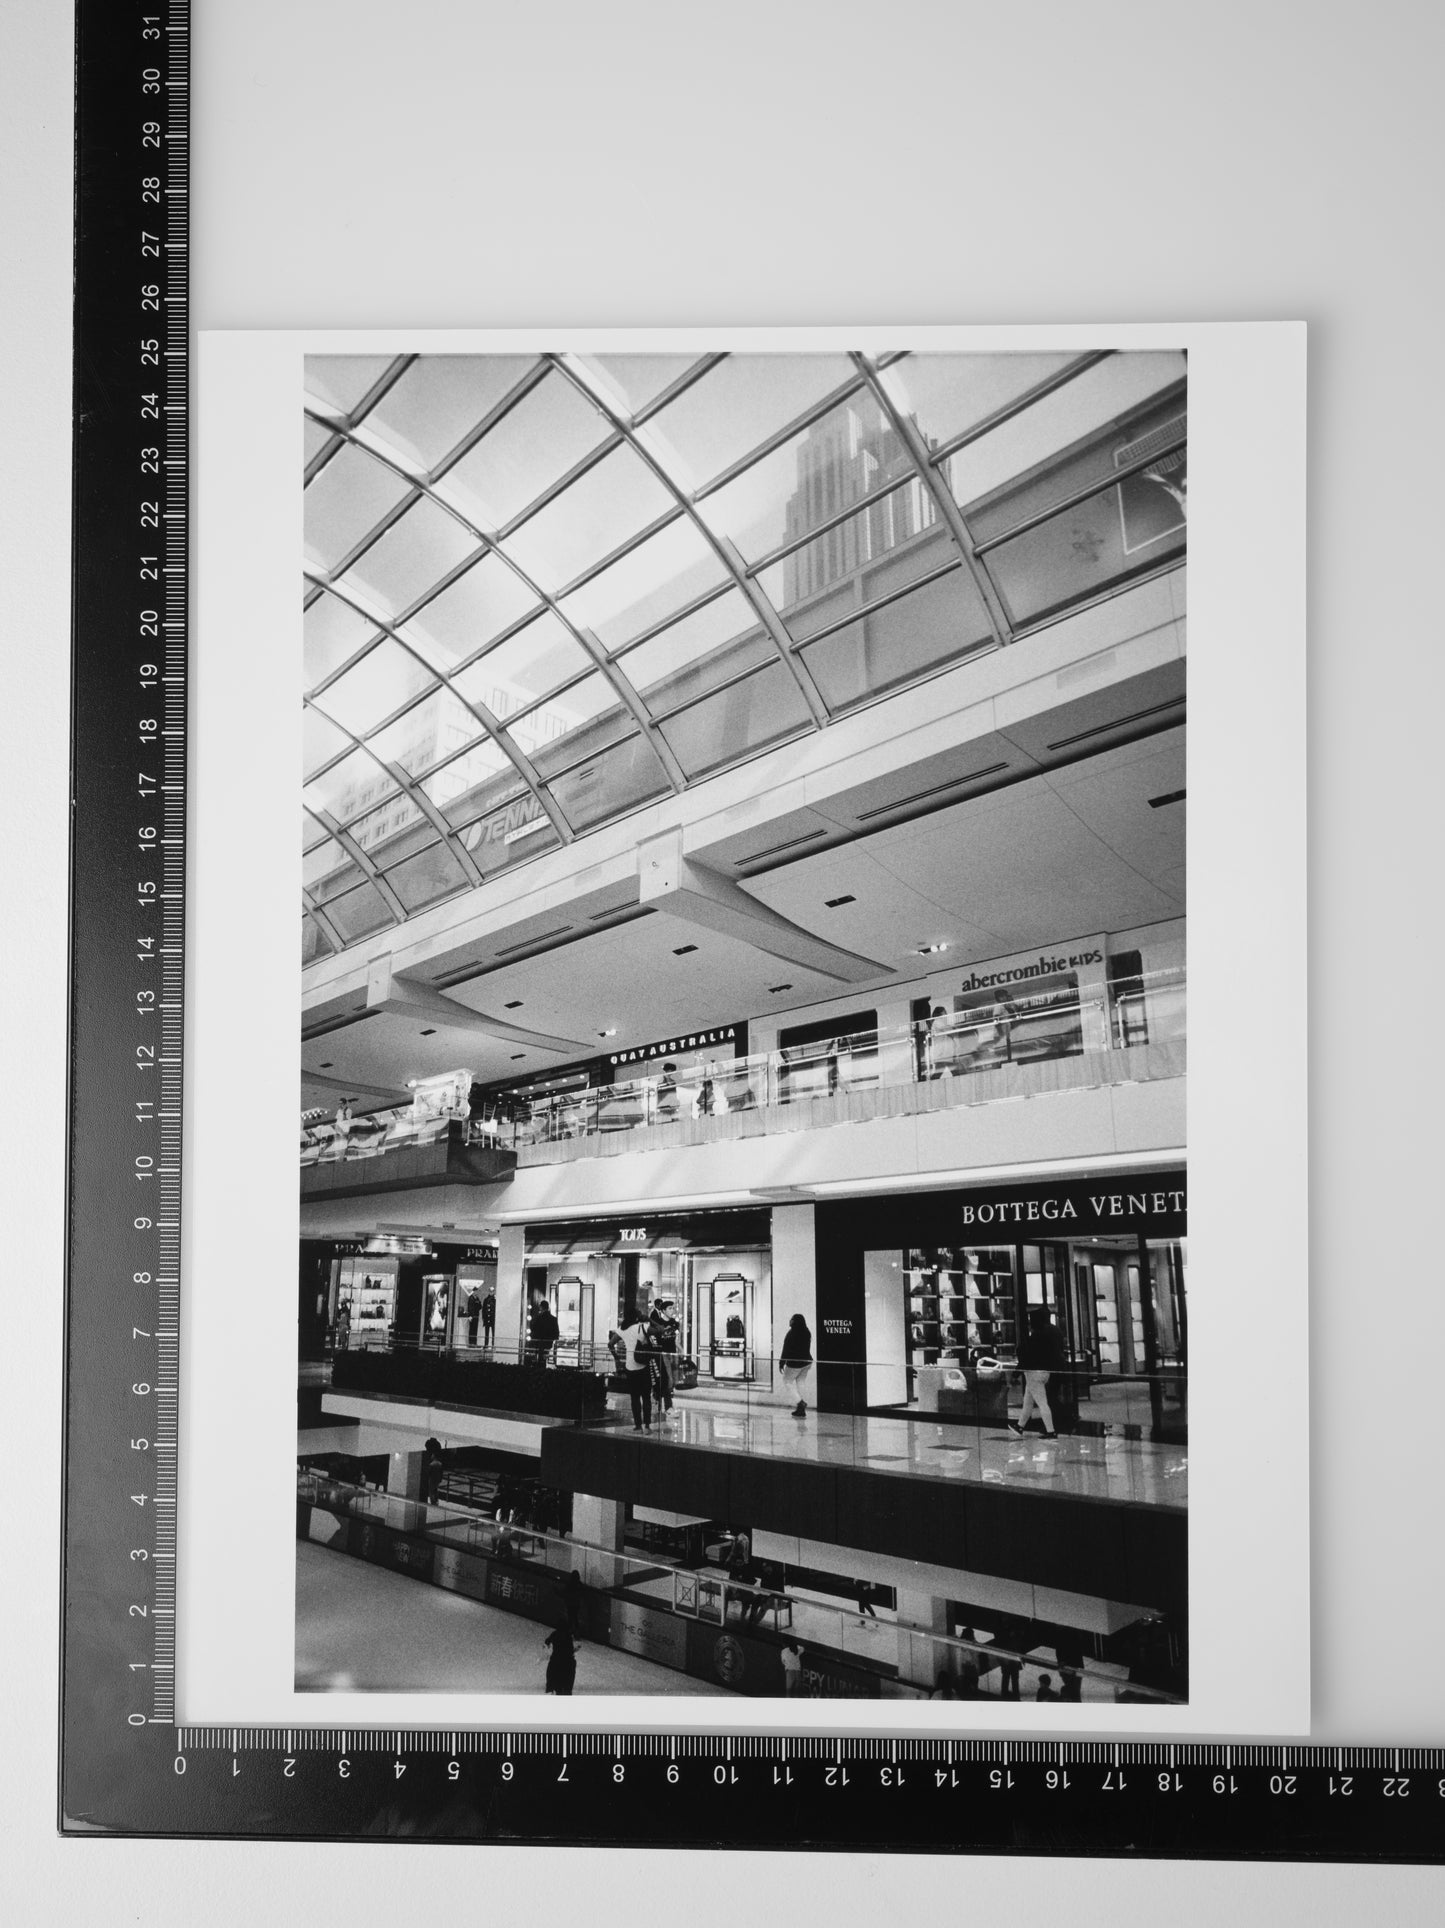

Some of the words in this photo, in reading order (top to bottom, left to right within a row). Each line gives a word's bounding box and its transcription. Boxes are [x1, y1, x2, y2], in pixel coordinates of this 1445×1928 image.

[142, 16, 161, 40] 31
[142, 68, 160, 94] 30
[142, 122, 161, 148] 29
[142, 177, 160, 203] 28
[141, 231, 160, 257] 27
[141, 284, 160, 311] 26
[140, 339, 159, 366] 25
[141, 392, 159, 419] 24
[140, 447, 159, 474] 23
[140, 501, 159, 528] 22
[140, 557, 158, 581] 21
[139, 610, 158, 637] 20
[139, 664, 158, 689] 19
[139, 718, 158, 744] 18
[138, 772, 157, 798] 17
[138, 826, 157, 852] 16
[137, 881, 157, 907] 15
[136, 936, 155, 962] 14
[962, 956, 1067, 992] abercrombie
[1069, 949, 1103, 968] KIDS
[136, 990, 155, 1016] 13
[610, 1048, 645, 1065] QUAY
[649, 1028, 735, 1056] AUSTRALIA
[136, 1045, 155, 1071] 12
[135, 1102, 154, 1123] 11
[134, 1155, 154, 1181] 10
[962, 1198, 1078, 1224] BOTTEGA
[1089, 1191, 1188, 1217] VENET
[133, 1216, 153, 1230] 9
[334, 1243, 364, 1254] PRA
[132, 1271, 152, 1284] 8
[823, 1319, 853, 1327] BOTTEGA
[825, 1326, 851, 1335] VENETA
[132, 1326, 151, 1340] 7
[131, 1382, 151, 1396] 6
[130, 1437, 149, 1451] 5
[130, 1493, 149, 1507] 4
[129, 1548, 149, 1562] 3
[128, 1604, 148, 1618] 2
[128, 1663, 147, 1672] 1
[127, 1713, 146, 1726] 0
[174, 1756, 187, 1775] 0
[233, 1758, 241, 1777] 1
[283, 1758, 296, 1777] 2
[338, 1759, 351, 1778] 3
[393, 1760, 407, 1779] 4
[447, 1761, 460, 1780] 5
[501, 1762, 514, 1781] 6
[557, 1763, 569, 1782] 7
[612, 1764, 625, 1783] 8
[666, 1764, 679, 1783] 9
[713, 1765, 739, 1784] 10
[773, 1766, 794, 1785] 11
[825, 1767, 850, 1786] 12
[880, 1767, 905, 1786] 13
[934, 1769, 960, 1788] 14
[989, 1769, 1015, 1789] 15
[1045, 1770, 1071, 1789] 16
[1102, 1771, 1127, 1790] 17
[1158, 1772, 1183, 1792] 18
[1212, 1775, 1238, 1794] 19
[1270, 1775, 1297, 1795] 20
[1329, 1776, 1353, 1796] 21
[1383, 1778, 1410, 1797] 22
